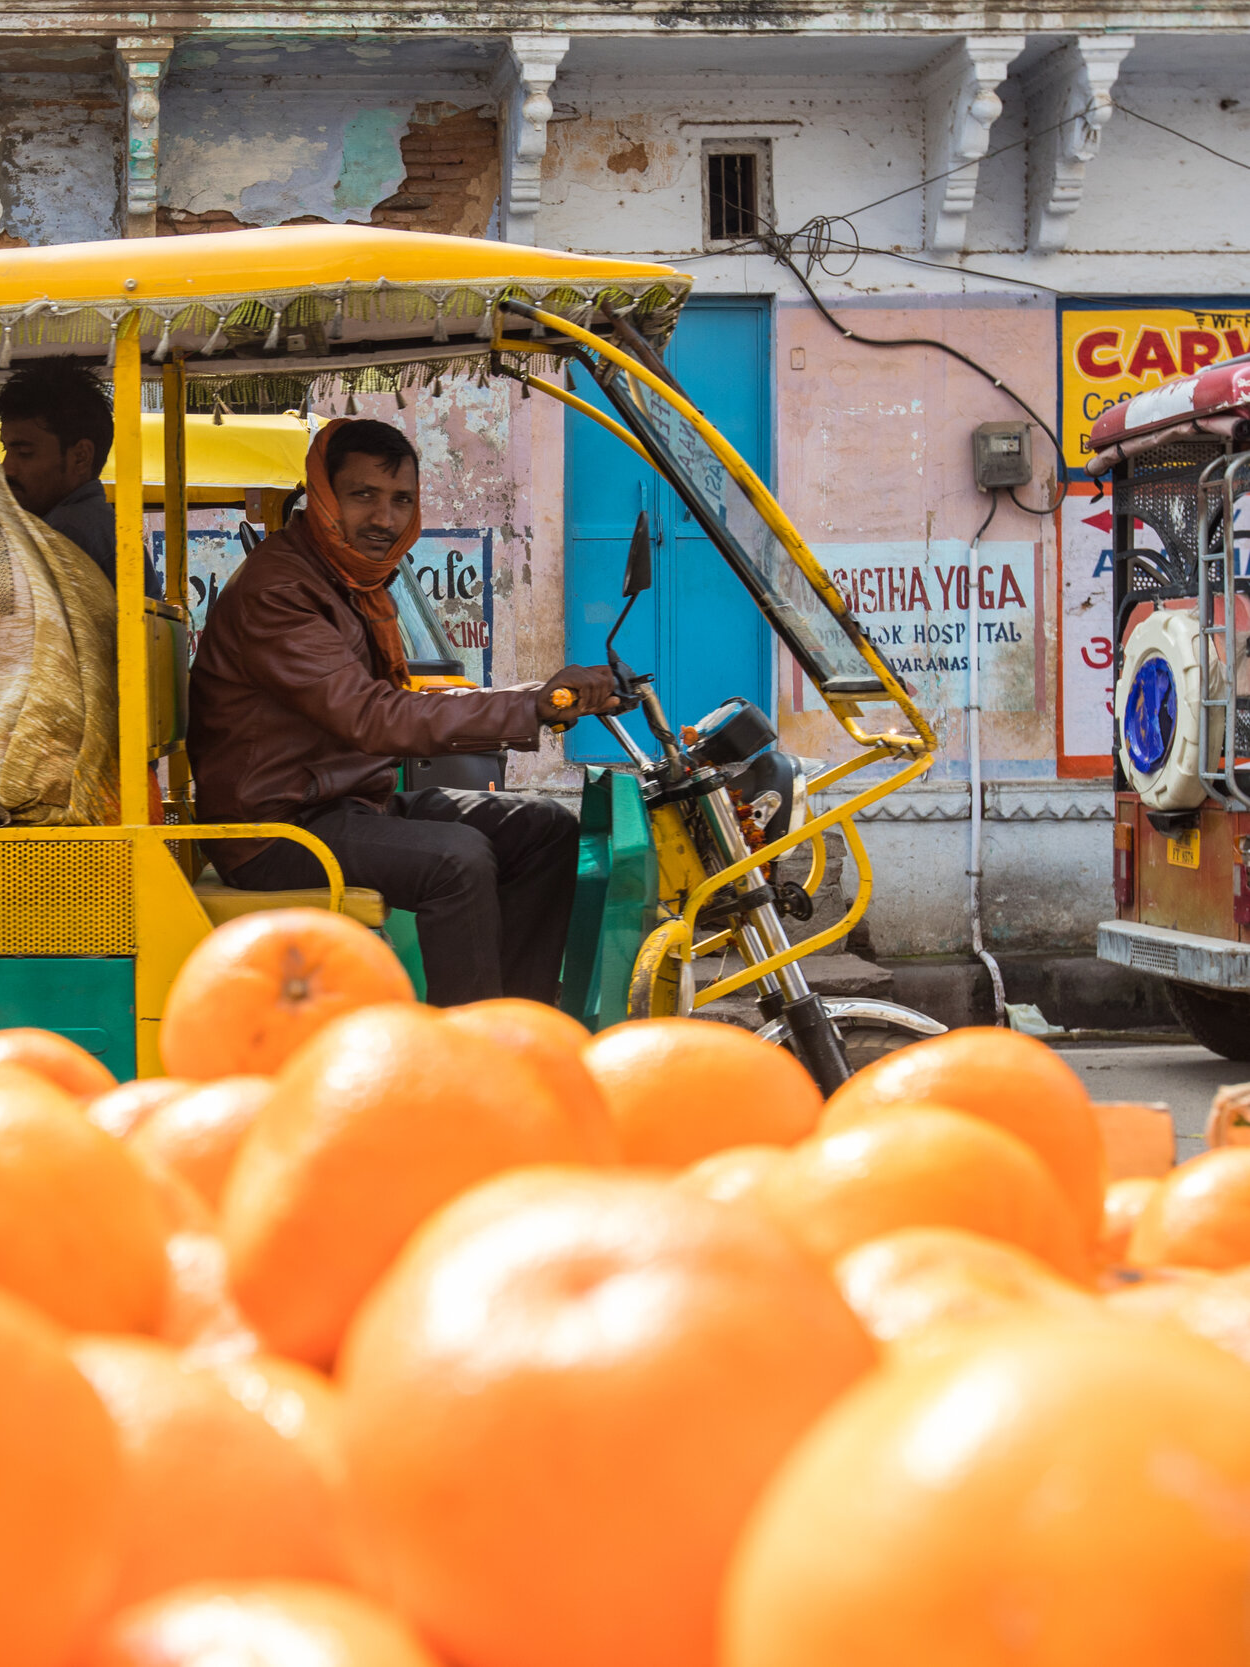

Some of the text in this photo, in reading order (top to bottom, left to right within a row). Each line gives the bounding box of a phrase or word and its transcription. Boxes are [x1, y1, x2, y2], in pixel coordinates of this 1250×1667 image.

[406, 549, 477, 600] afe
[824, 564, 1027, 614] SISTHA YOGA
